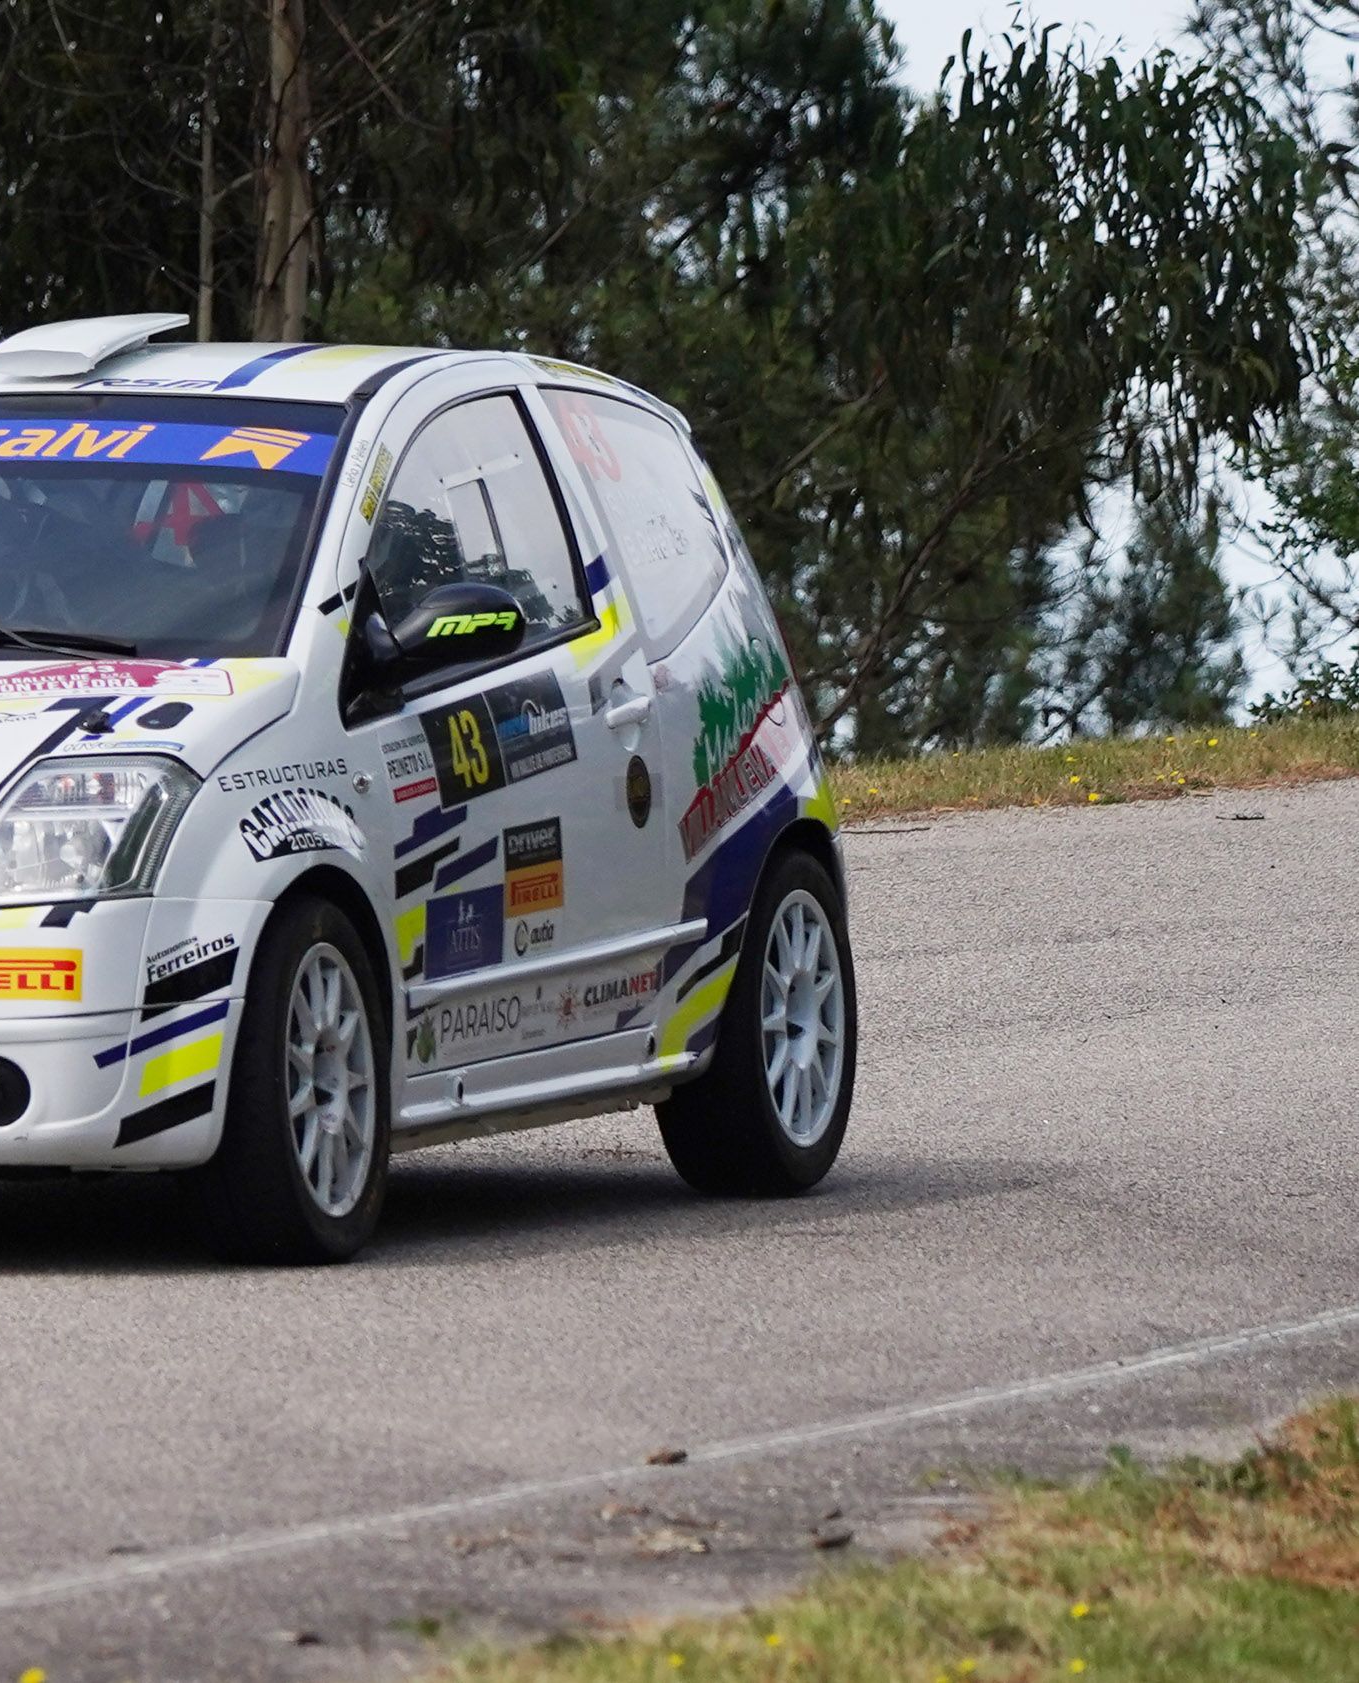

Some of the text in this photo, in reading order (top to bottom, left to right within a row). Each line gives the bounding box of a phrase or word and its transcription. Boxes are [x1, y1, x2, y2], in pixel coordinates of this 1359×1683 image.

[12, 675, 67, 685] RALLYE
[69, 673, 89, 682] DE
[76, 665, 116, 674] 43
[448, 709, 489, 788] 43
[218, 758, 348, 792] ESTRUCTURAS
[510, 872, 559, 907] PIRELLI
[146, 932, 235, 983] Ferreiros
[583, 972, 657, 1008] CLIMANET
[440, 996, 522, 1043] PARAISO
